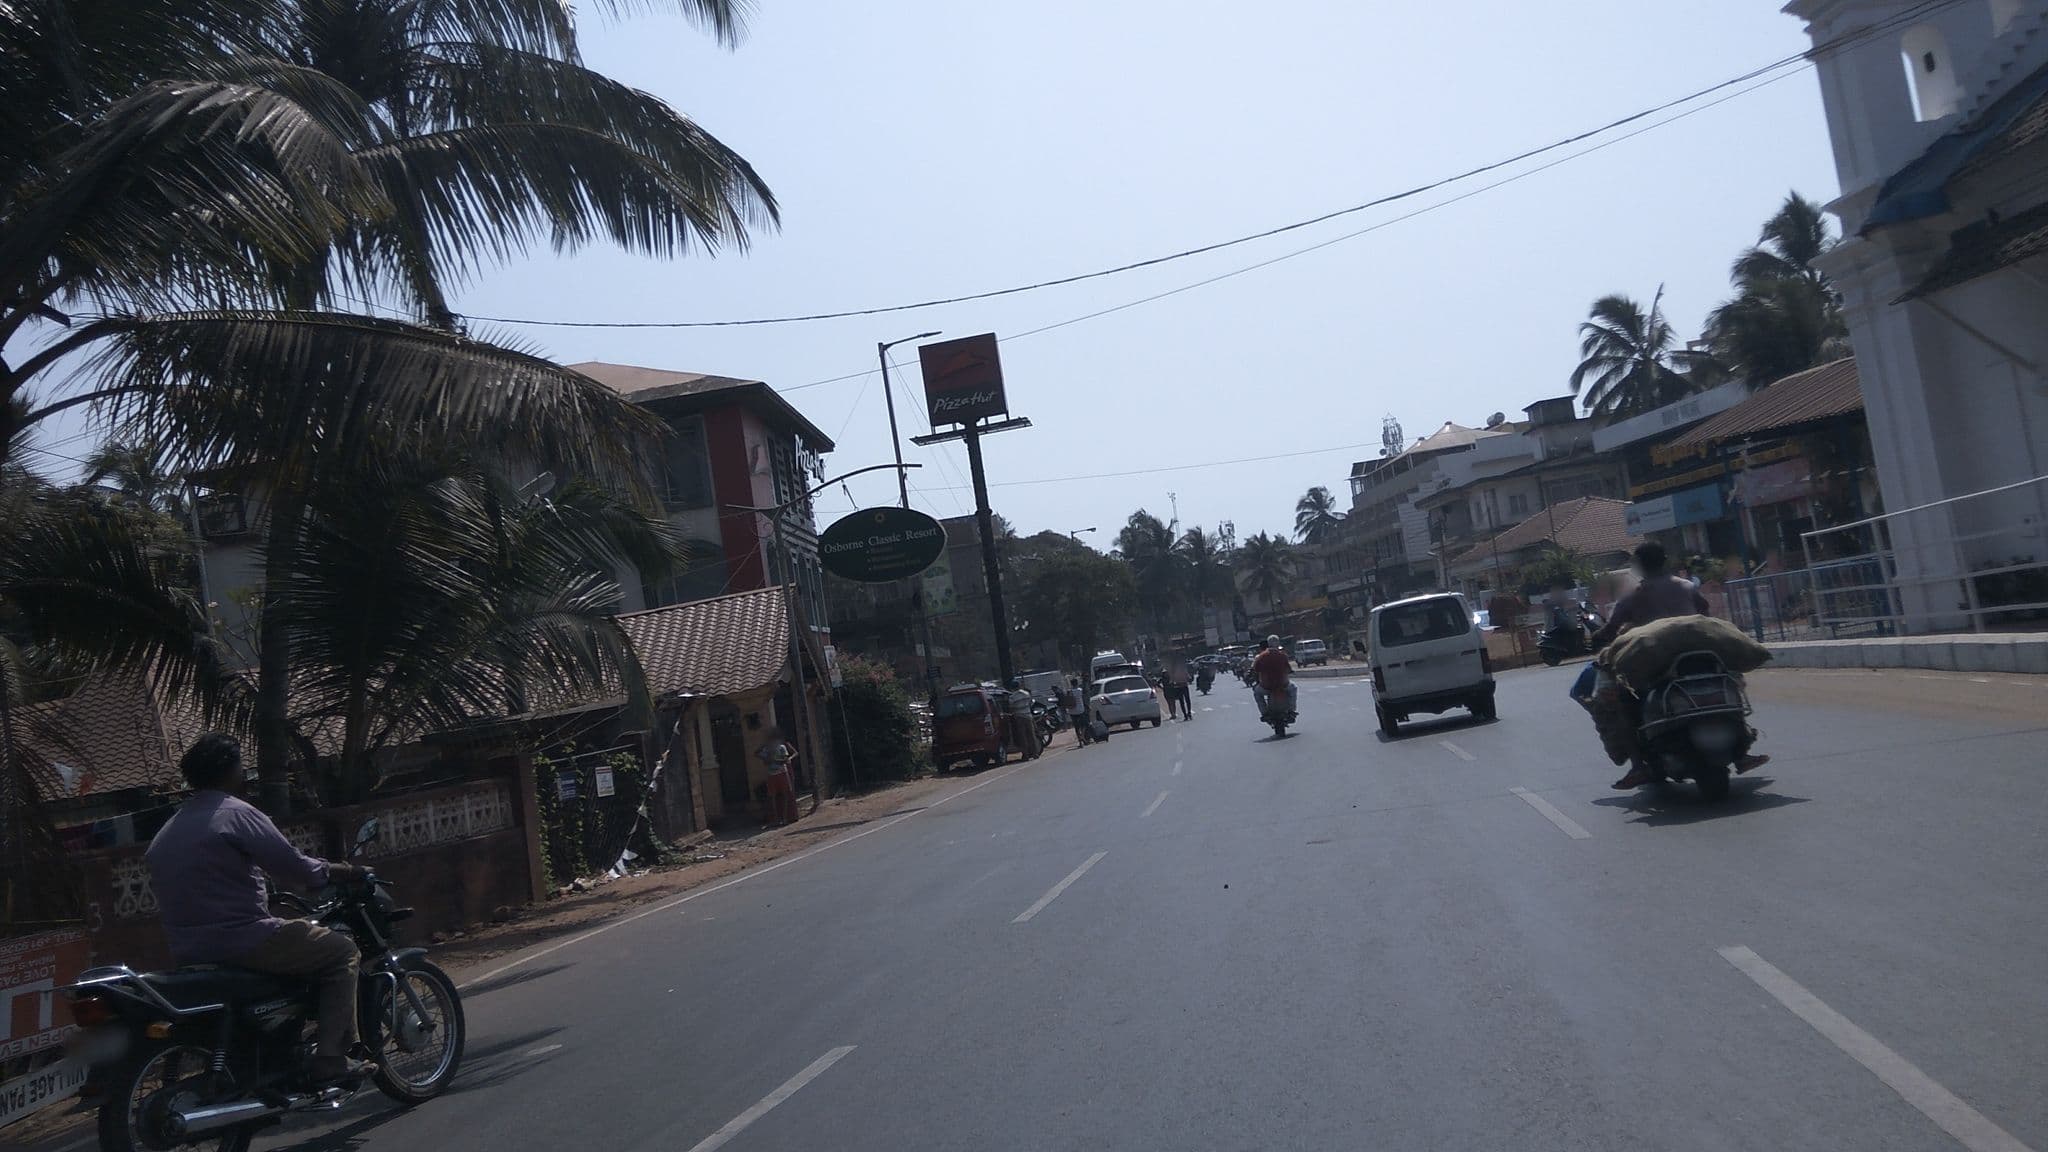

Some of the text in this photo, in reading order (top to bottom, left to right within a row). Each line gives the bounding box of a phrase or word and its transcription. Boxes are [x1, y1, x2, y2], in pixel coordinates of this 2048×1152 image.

[933, 391, 996, 414] Pizza Hut
[823, 538, 864, 554] Osborne
[867, 533, 902, 547] Classic
[904, 527, 938, 541] Resort
[24, 964, 56, 983] LOVE
